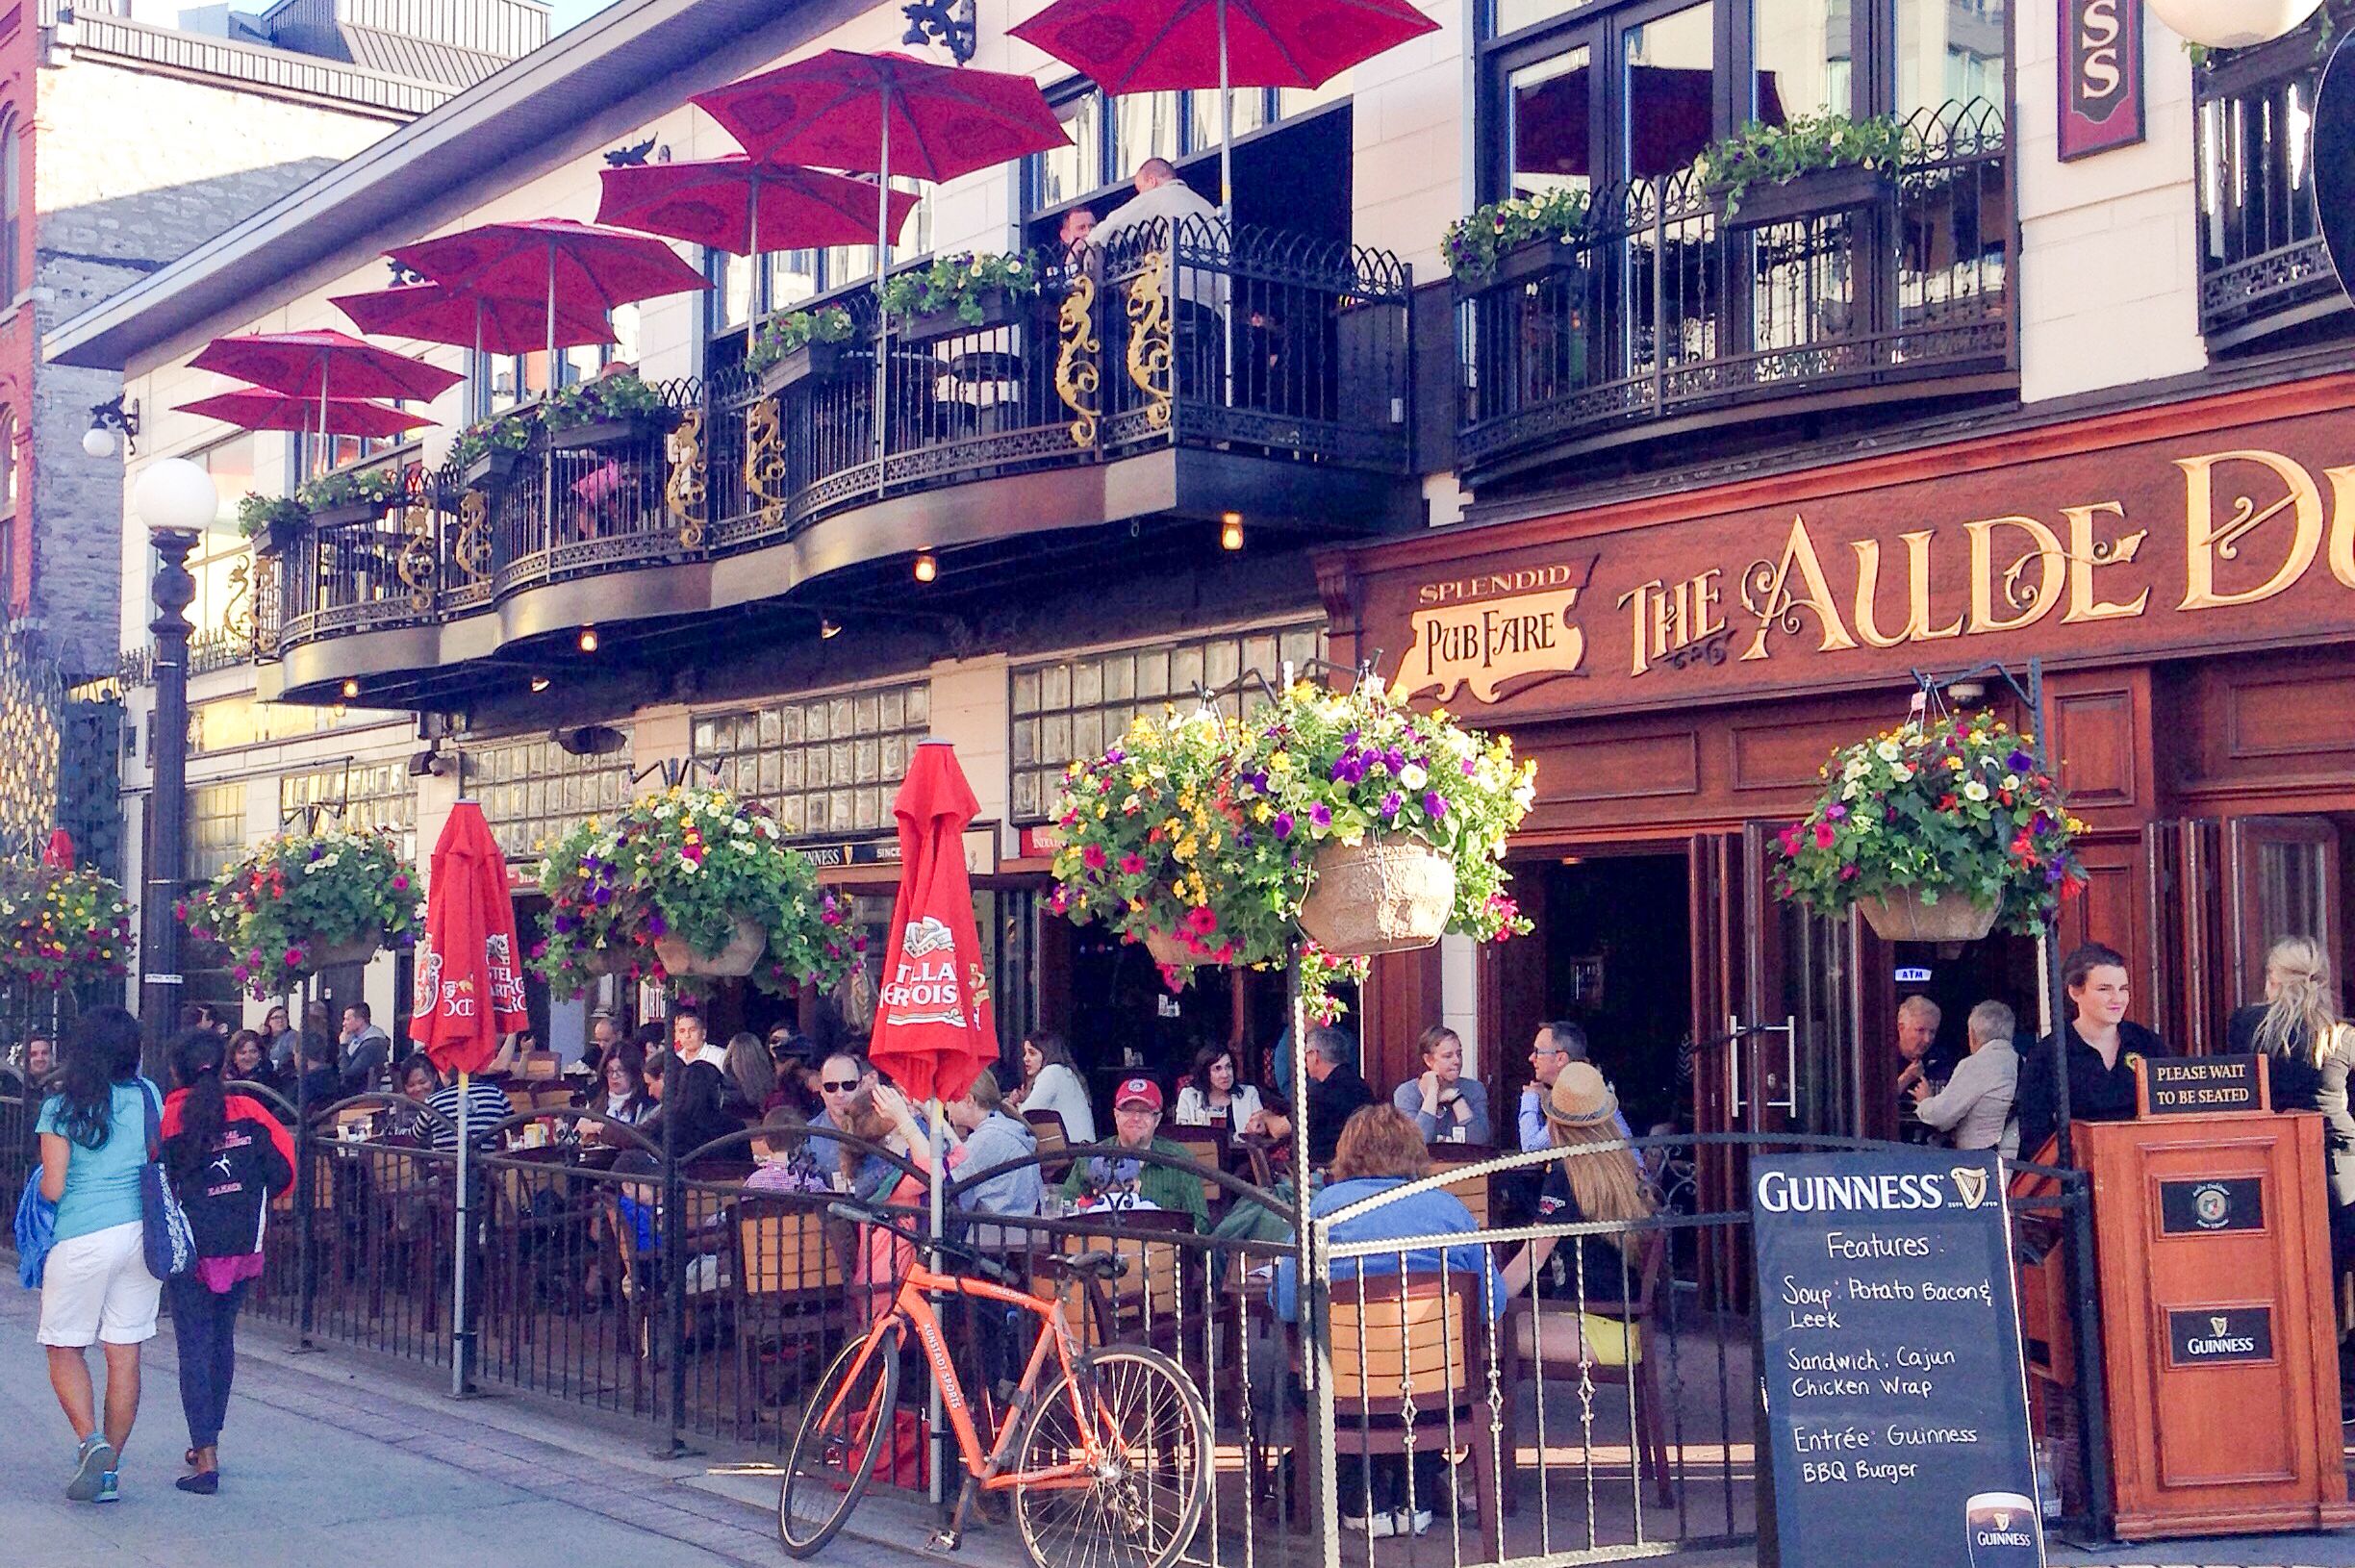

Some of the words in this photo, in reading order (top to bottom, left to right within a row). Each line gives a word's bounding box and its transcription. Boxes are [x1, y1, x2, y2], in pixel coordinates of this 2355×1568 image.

[1616, 568, 1726, 677] THE
[1739, 499, 2151, 663] AULDE
[2171, 448, 2355, 612] D
[1419, 565, 1572, 604] SPLENDID
[1482, 610, 1557, 669] FARE
[1902, 970, 1923, 978] ATM
[2157, 1065, 2207, 1081] PLEASE
[2209, 1064, 2246, 1079] WAIT
[2157, 1091, 2176, 1105] TO
[2179, 1090, 2196, 1104] BE
[2198, 1087, 2250, 1103] SEATED
[1758, 1171, 1944, 1212] GUINNESS
[1848, 1277, 1914, 1300] Potato
[1789, 1310, 1841, 1328] Leek
[2187, 1337, 2254, 1354] GUINNESS
[923, 1323, 948, 1372] KUNSTADT
[941, 1372, 962, 1409] SPORTS
[1896, 1346, 1956, 1372] Cajun
[1791, 1378, 1870, 1397] Chicken
[1879, 1376, 1933, 1399] Wrap
[1887, 1424, 1978, 1446] Guinness
[1802, 1461, 1848, 1483] BBQ
[1856, 1459, 1918, 1484] Burger
[1977, 1531, 2031, 1547] GUINNESS
